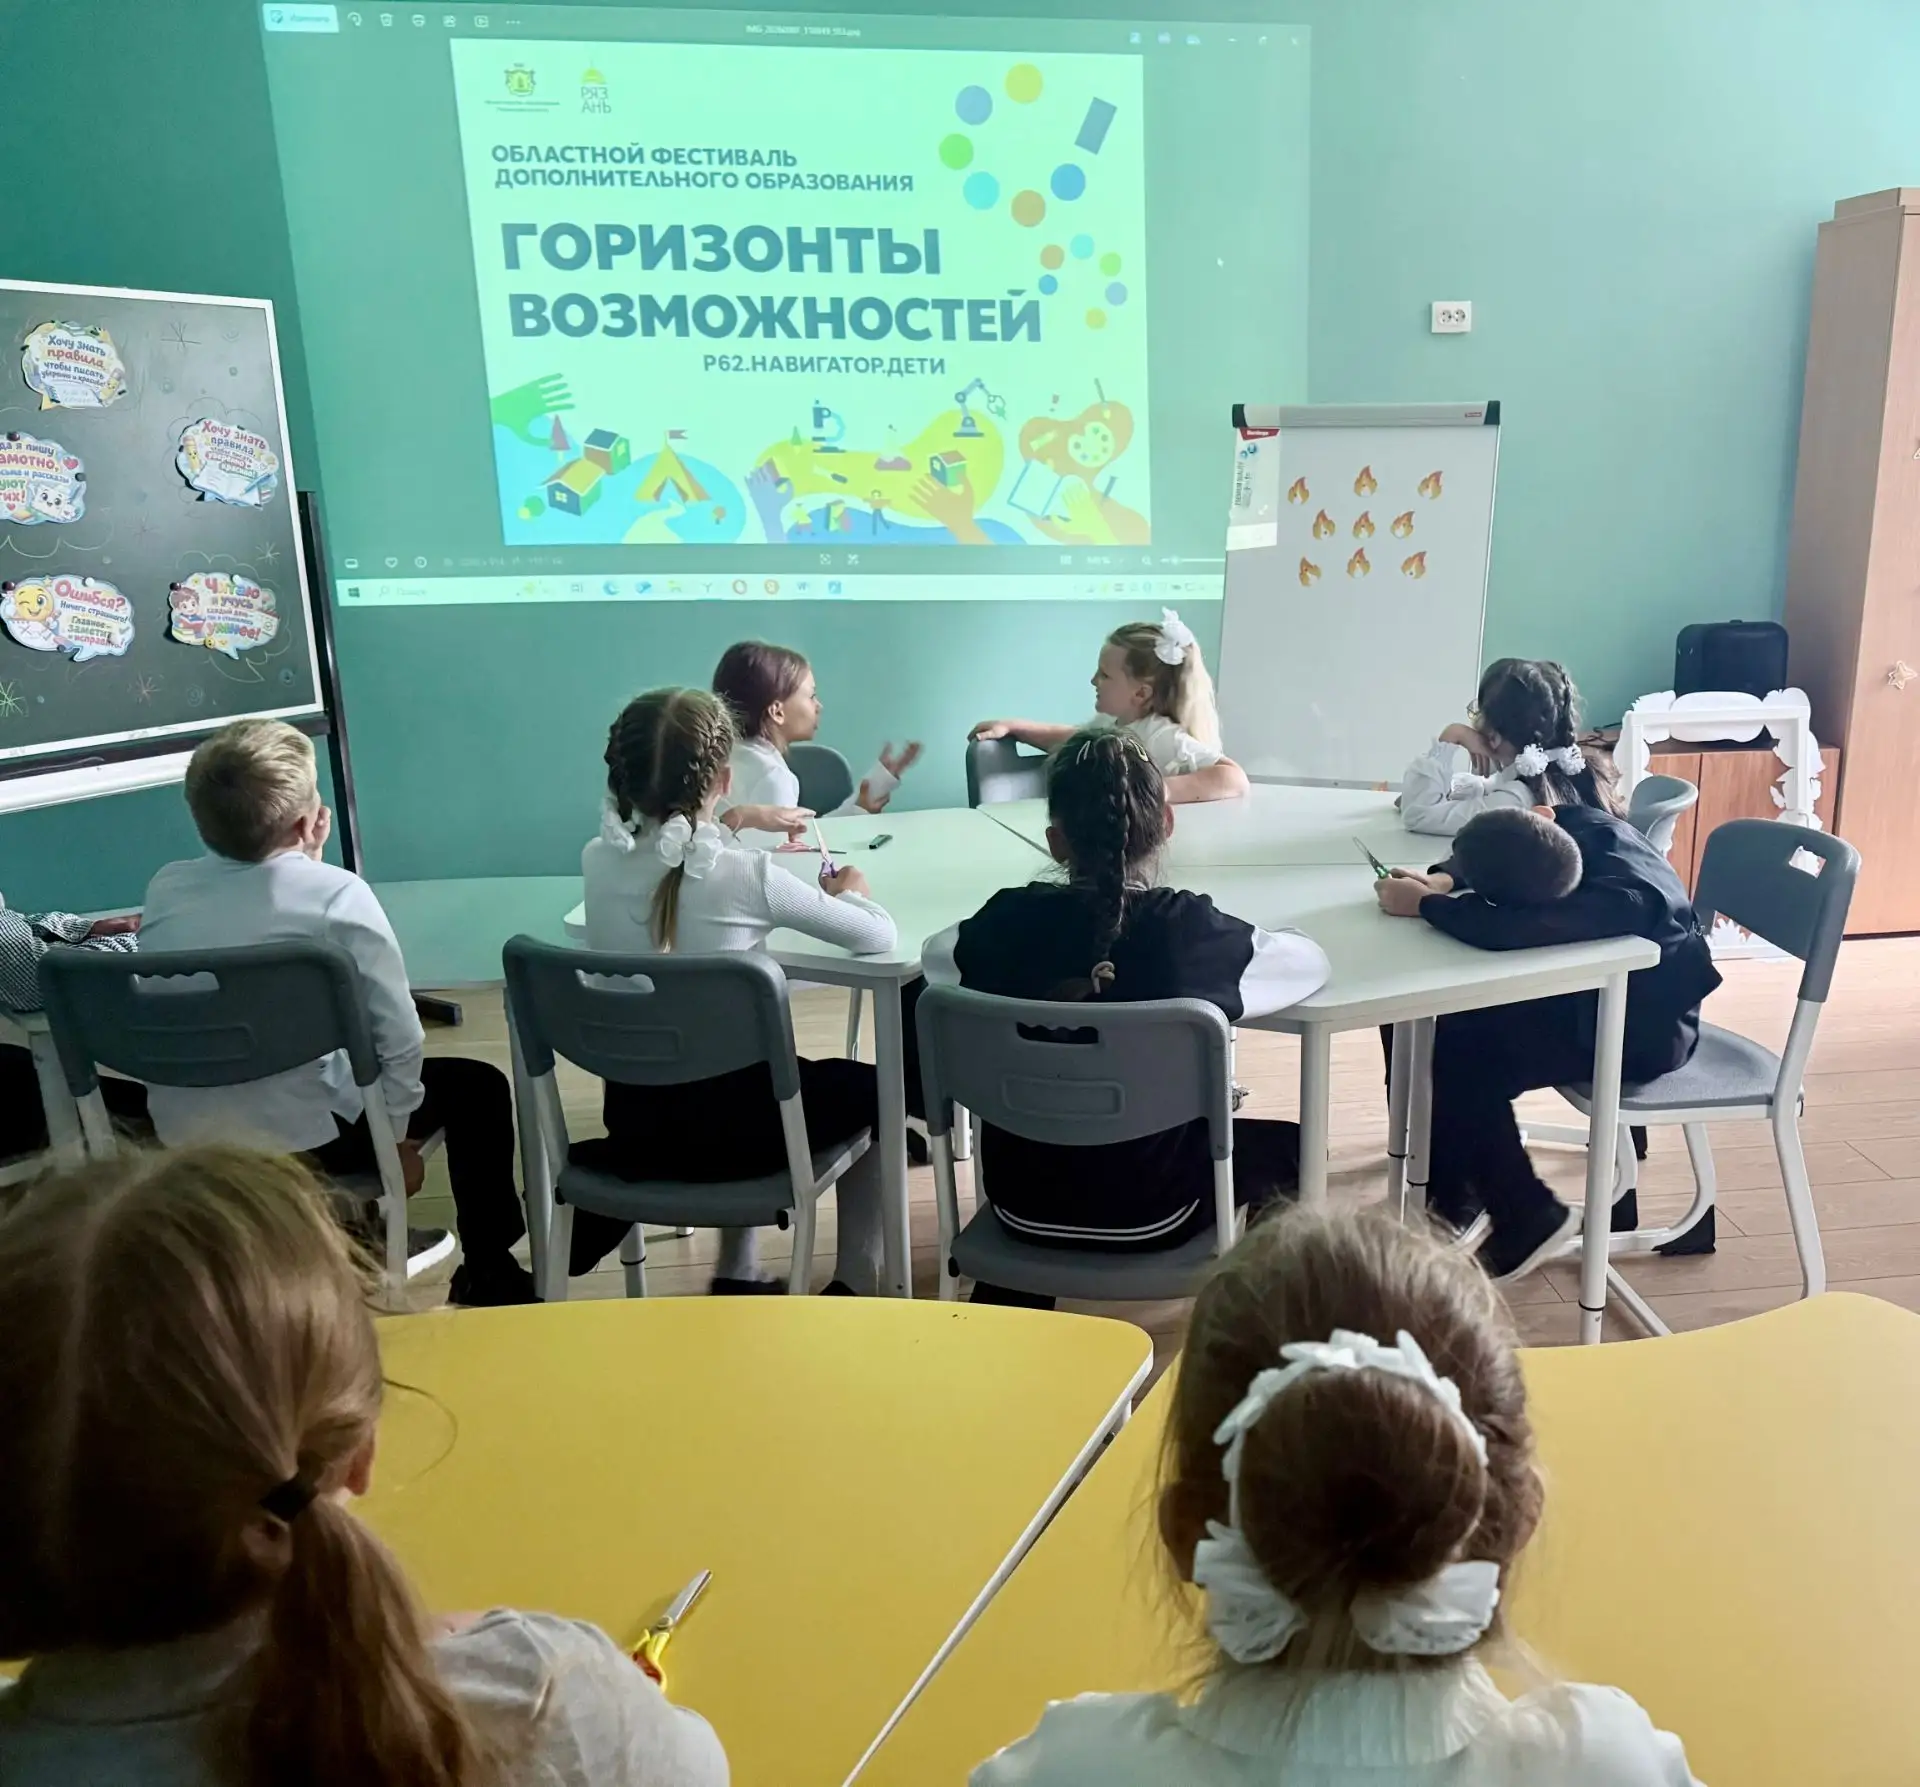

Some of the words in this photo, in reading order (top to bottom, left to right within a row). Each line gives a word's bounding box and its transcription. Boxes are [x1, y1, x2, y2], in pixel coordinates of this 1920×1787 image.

[580, 86, 609, 100] РЯЗ
[580, 100, 612, 114] АНЬ
[491, 142, 645, 165] ОБЛАСТНОЙ
[650, 147, 798, 167] ФЕСТИВАЛЬ
[494, 168, 739, 189] ДОПОЛНИТЕЛЬНОГО
[745, 172, 914, 192] ОБРАЗОВАНИЯ
[501, 222, 941, 275] ГОРИЗОНТЫ
[508, 289, 1042, 342] ВОЗМОЖНОСТЕЙ
[47, 334, 75, 349] Хочу
[77, 340, 106, 357] знать
[43, 361, 72, 371] чтобы
[73, 366, 105, 380] писать
[702, 354, 946, 377] Р62.НАВИГАТОР.ДЕТИ
[202, 420, 231, 437] Хочу
[234, 431, 266, 450] знать
[16, 442, 22, 450] я
[26, 444, 55, 457] пишу
[55, 579, 126, 611] Ошибся?
[205, 578, 260, 599] Читаю
